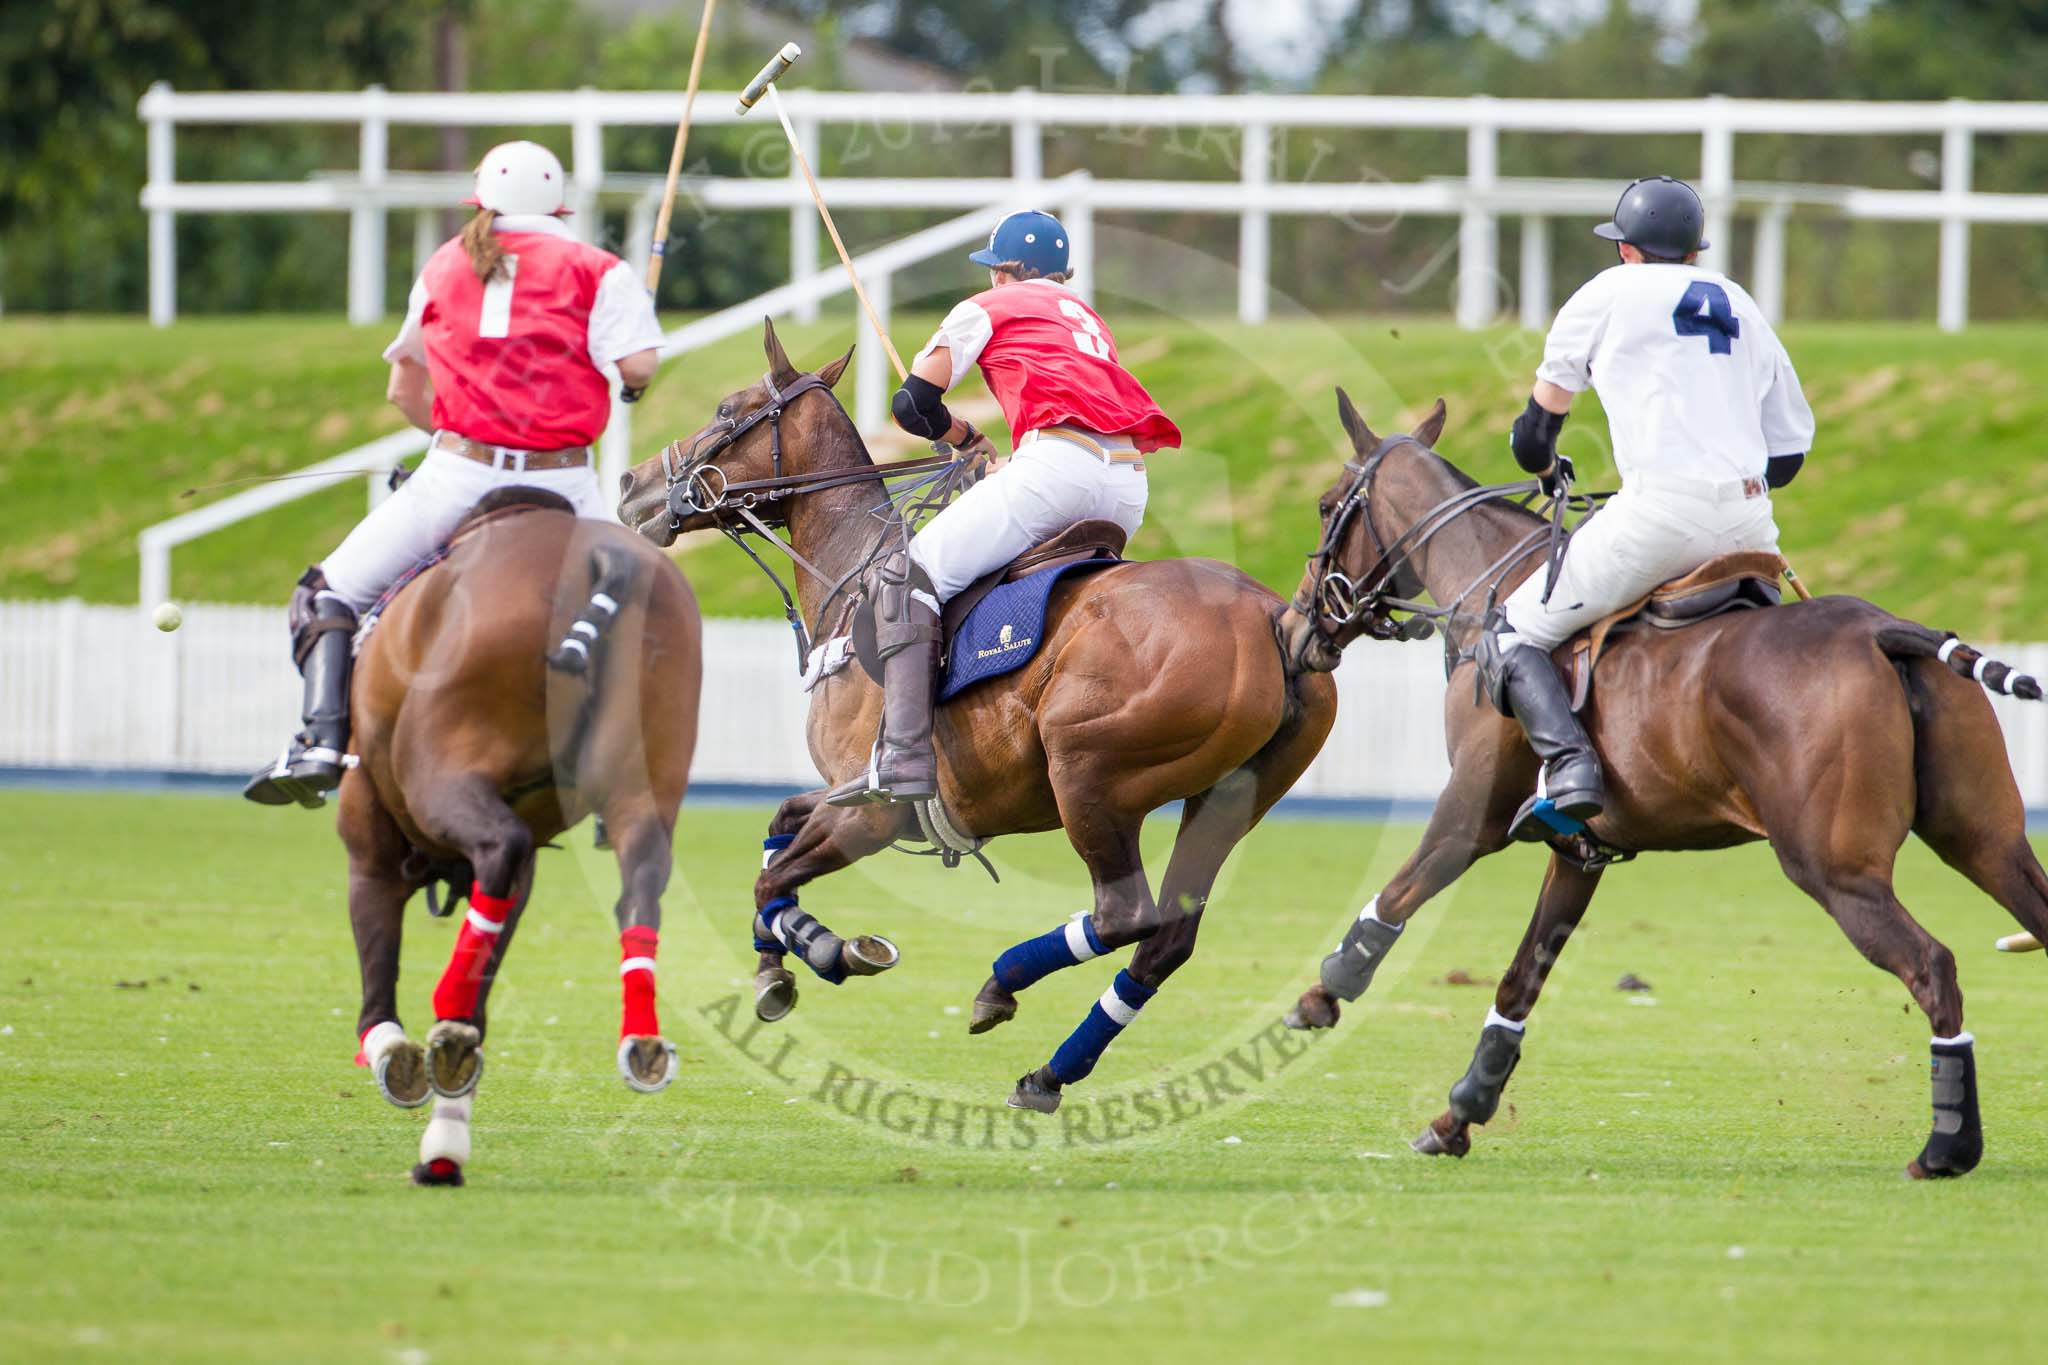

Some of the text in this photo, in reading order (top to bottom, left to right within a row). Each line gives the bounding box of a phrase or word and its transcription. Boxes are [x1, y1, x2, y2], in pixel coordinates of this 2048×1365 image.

[479, 253, 520, 338] 1
[1672, 280, 1740, 356] 4
[1058, 299, 1110, 362] 3
[978, 638, 1031, 658] ROYAL SALUTE
